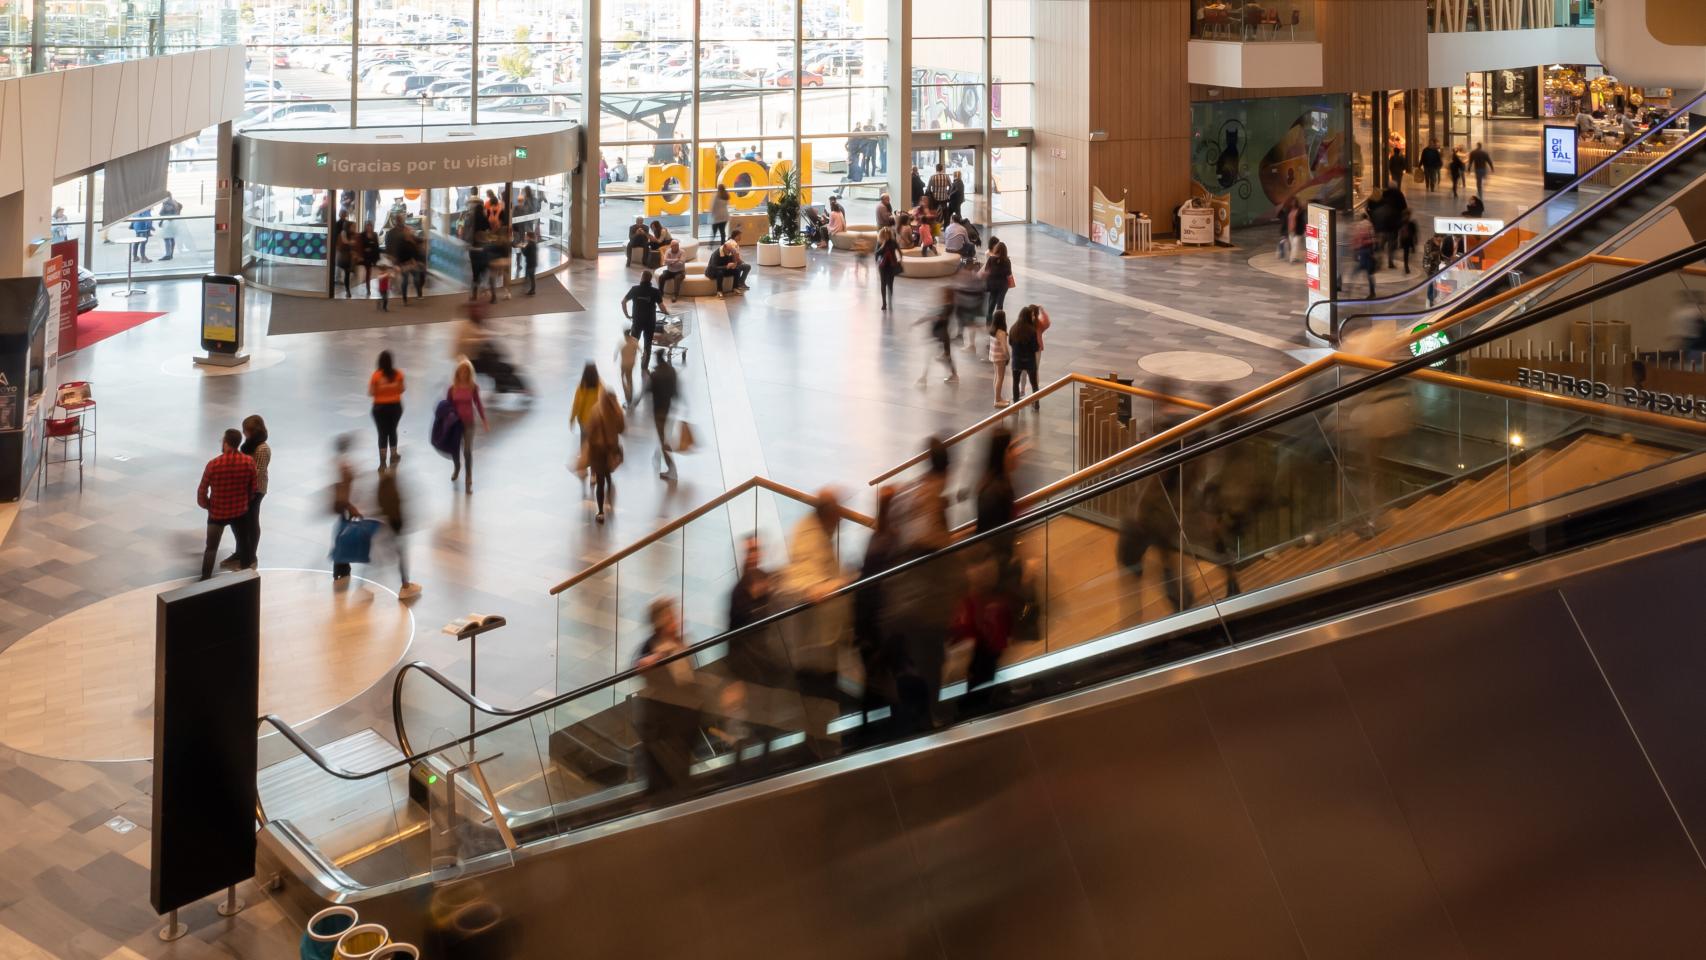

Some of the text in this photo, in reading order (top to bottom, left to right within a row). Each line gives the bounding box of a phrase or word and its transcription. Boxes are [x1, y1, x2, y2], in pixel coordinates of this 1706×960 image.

[1552, 151, 1571, 159] TAL
[407, 159, 436, 174] por
[443, 156, 461, 170] tu
[467, 152, 513, 169] visita!
[1448, 223, 1472, 231] ING
